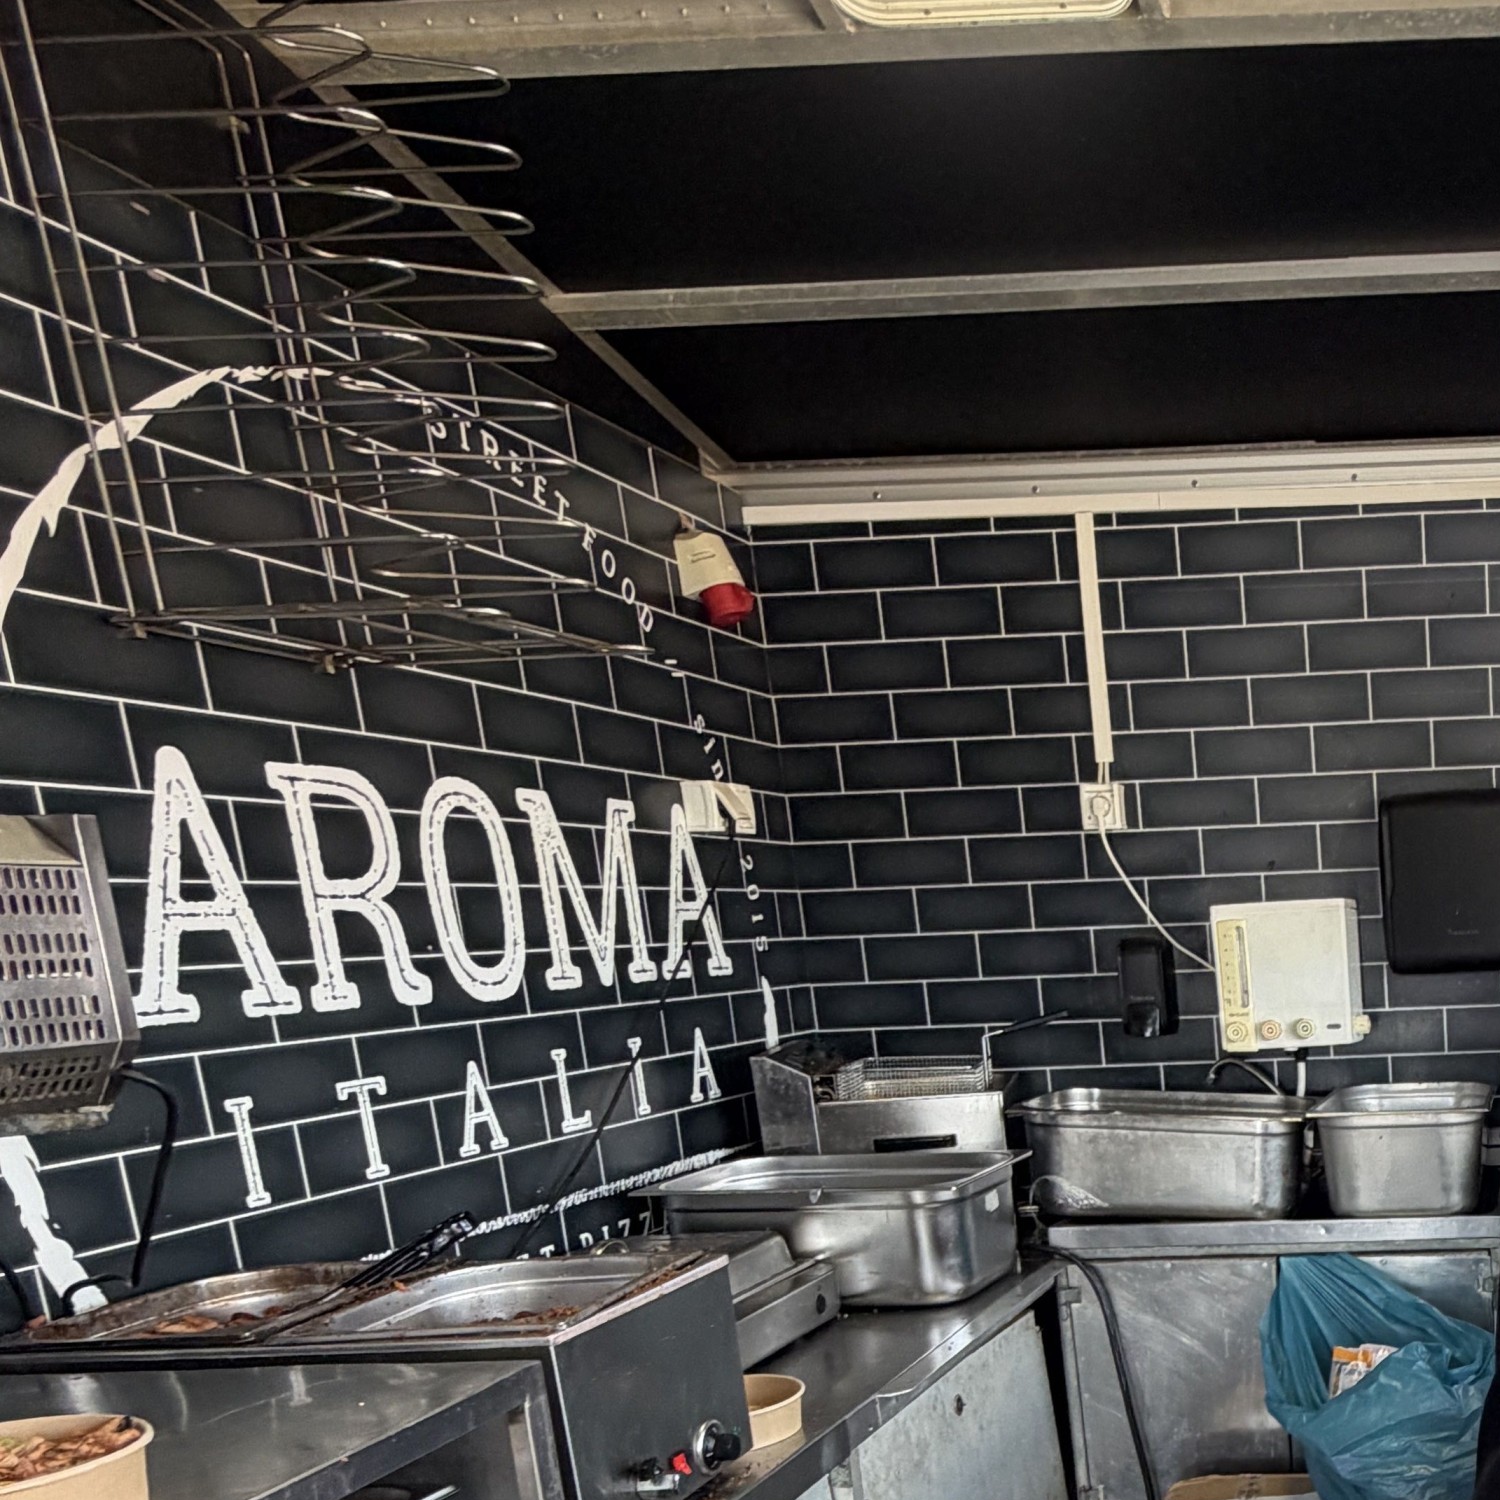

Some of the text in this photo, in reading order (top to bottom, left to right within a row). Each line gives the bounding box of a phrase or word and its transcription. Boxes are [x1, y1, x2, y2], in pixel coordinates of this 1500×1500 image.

[427, 409, 571, 522] STREET
[581, 522, 655, 633] FOOD
[739, 854, 769, 953] 2015
[134, 744, 732, 1028] AROMA
[223, 1025, 722, 1208] ITALIA
[578, 1209, 652, 1249] PIZZ
